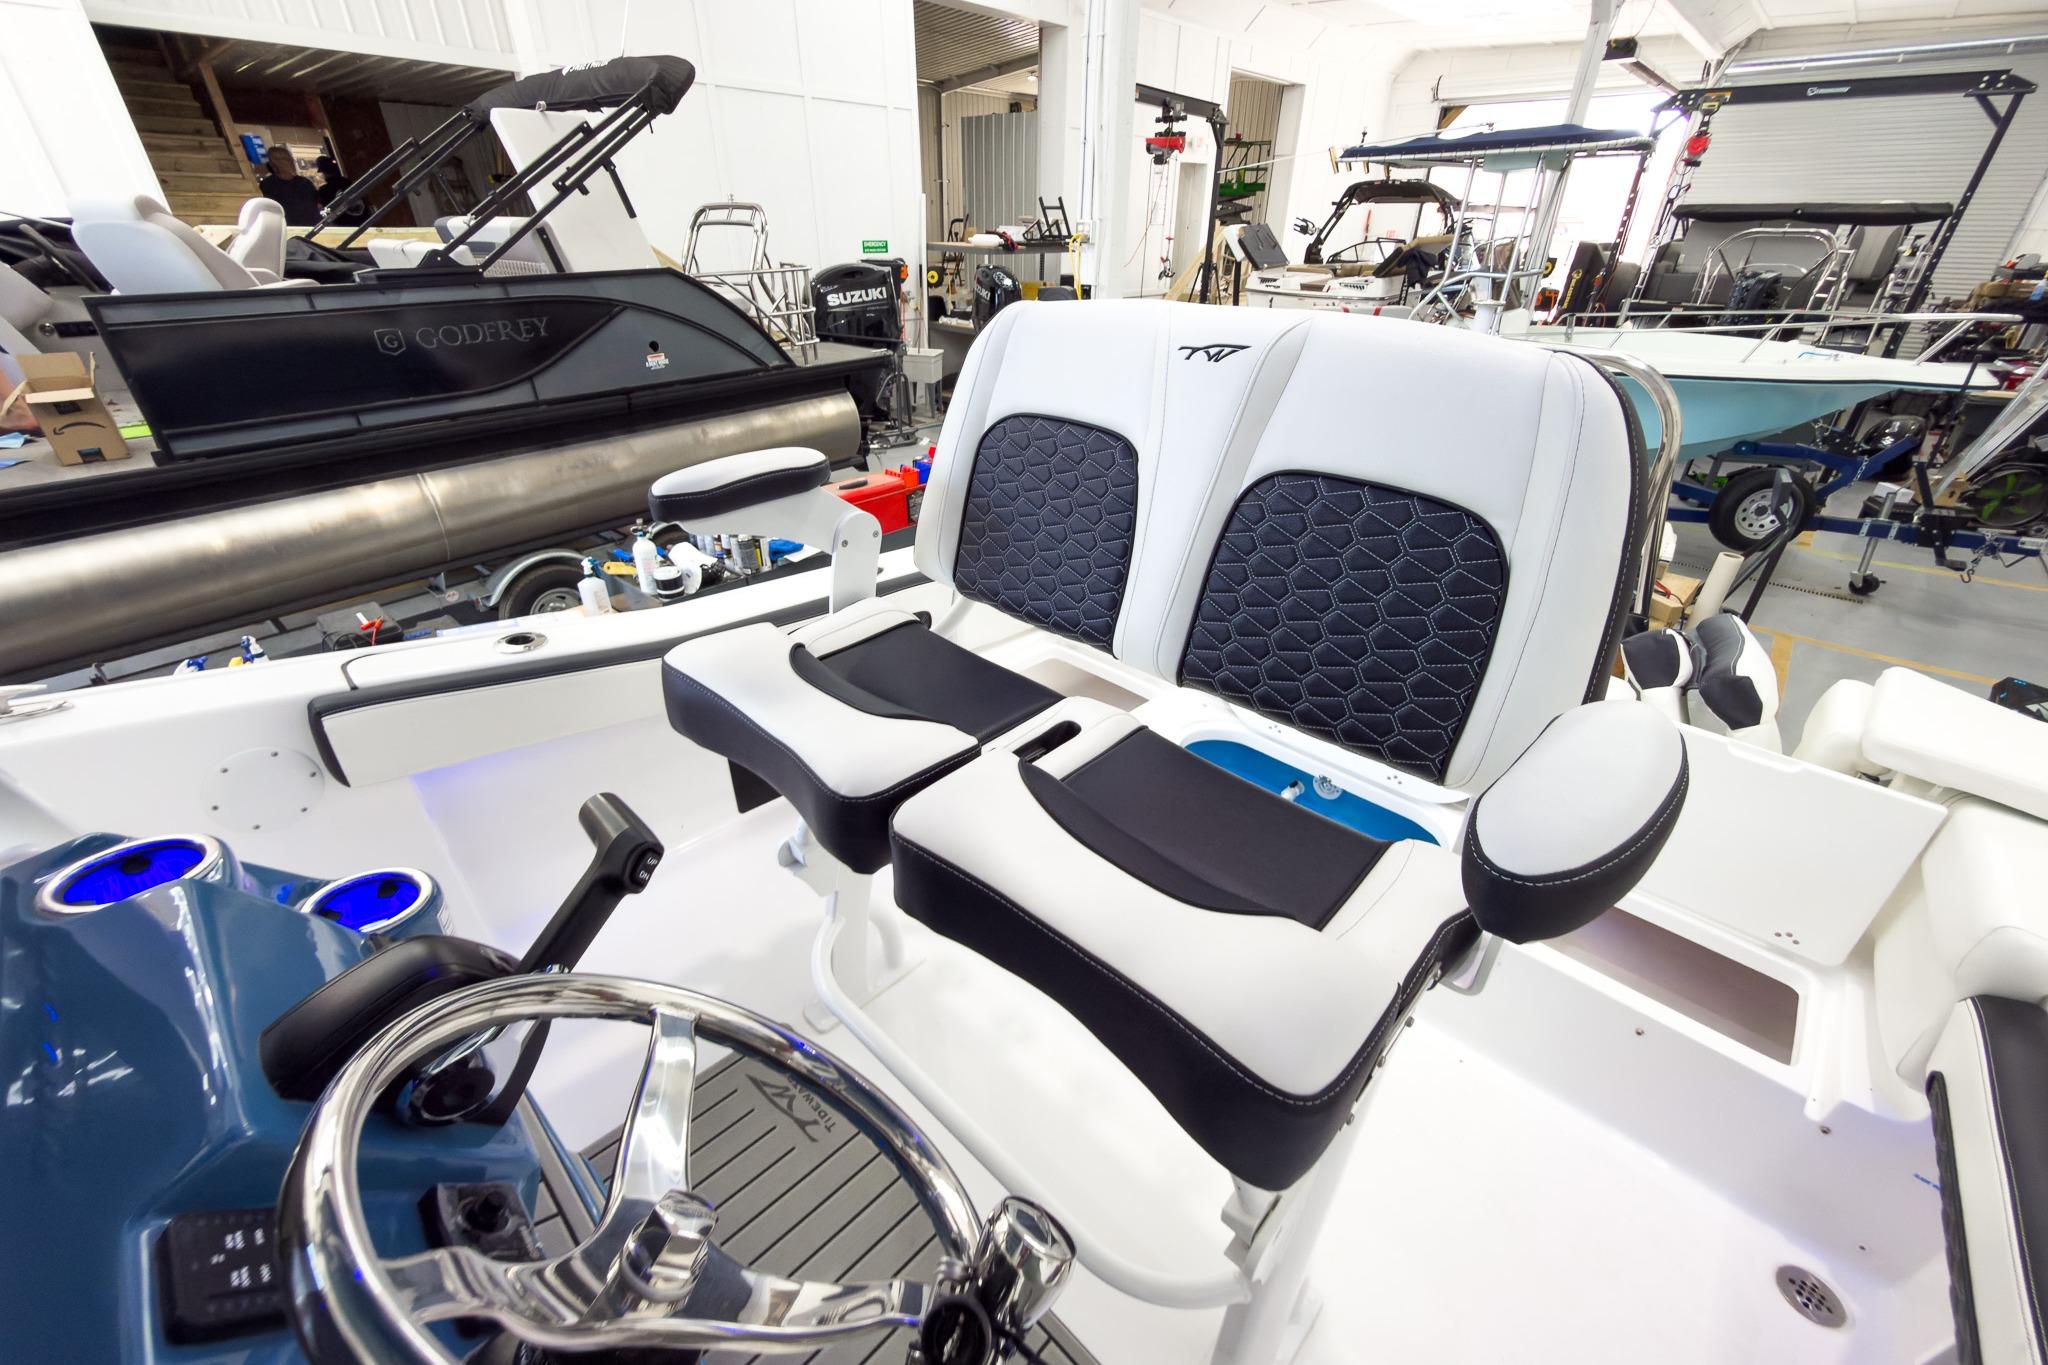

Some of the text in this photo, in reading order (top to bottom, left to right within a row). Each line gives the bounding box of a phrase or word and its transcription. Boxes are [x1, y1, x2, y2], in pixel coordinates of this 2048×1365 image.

[826, 286, 888, 307] SUZUKI
[415, 316, 549, 349] GODFREY
[646, 856, 659, 866] UP
[785, 1074, 837, 1133] TIDEWAT
